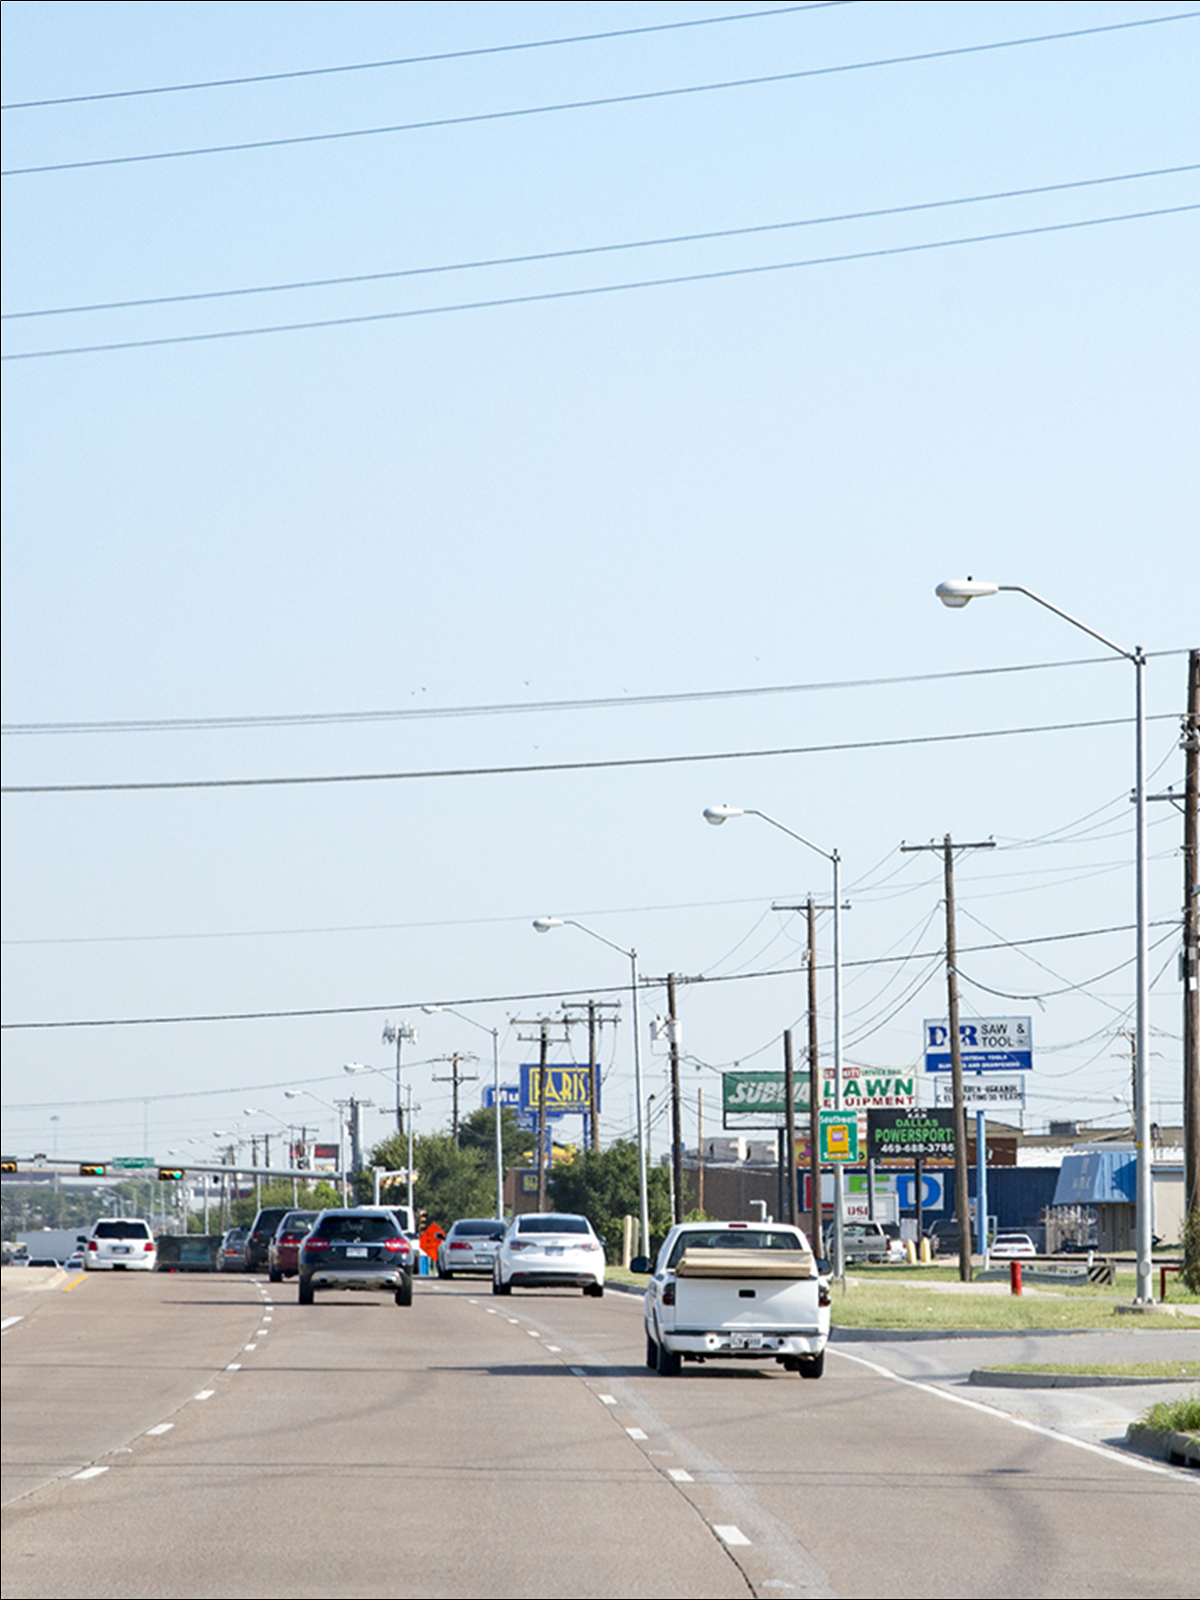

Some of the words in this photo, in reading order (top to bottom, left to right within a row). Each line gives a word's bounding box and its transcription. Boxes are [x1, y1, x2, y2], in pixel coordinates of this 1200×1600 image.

[981, 1024, 1008, 1035] SAW
[1016, 1023, 1025, 1034] &
[981, 1036, 1015, 1047] TOOL
[534, 1072, 587, 1101] PARIS
[823, 1079, 914, 1097] LAWN
[823, 1096, 915, 1107] EUIPMENT
[895, 1119, 938, 1127] DALLAS
